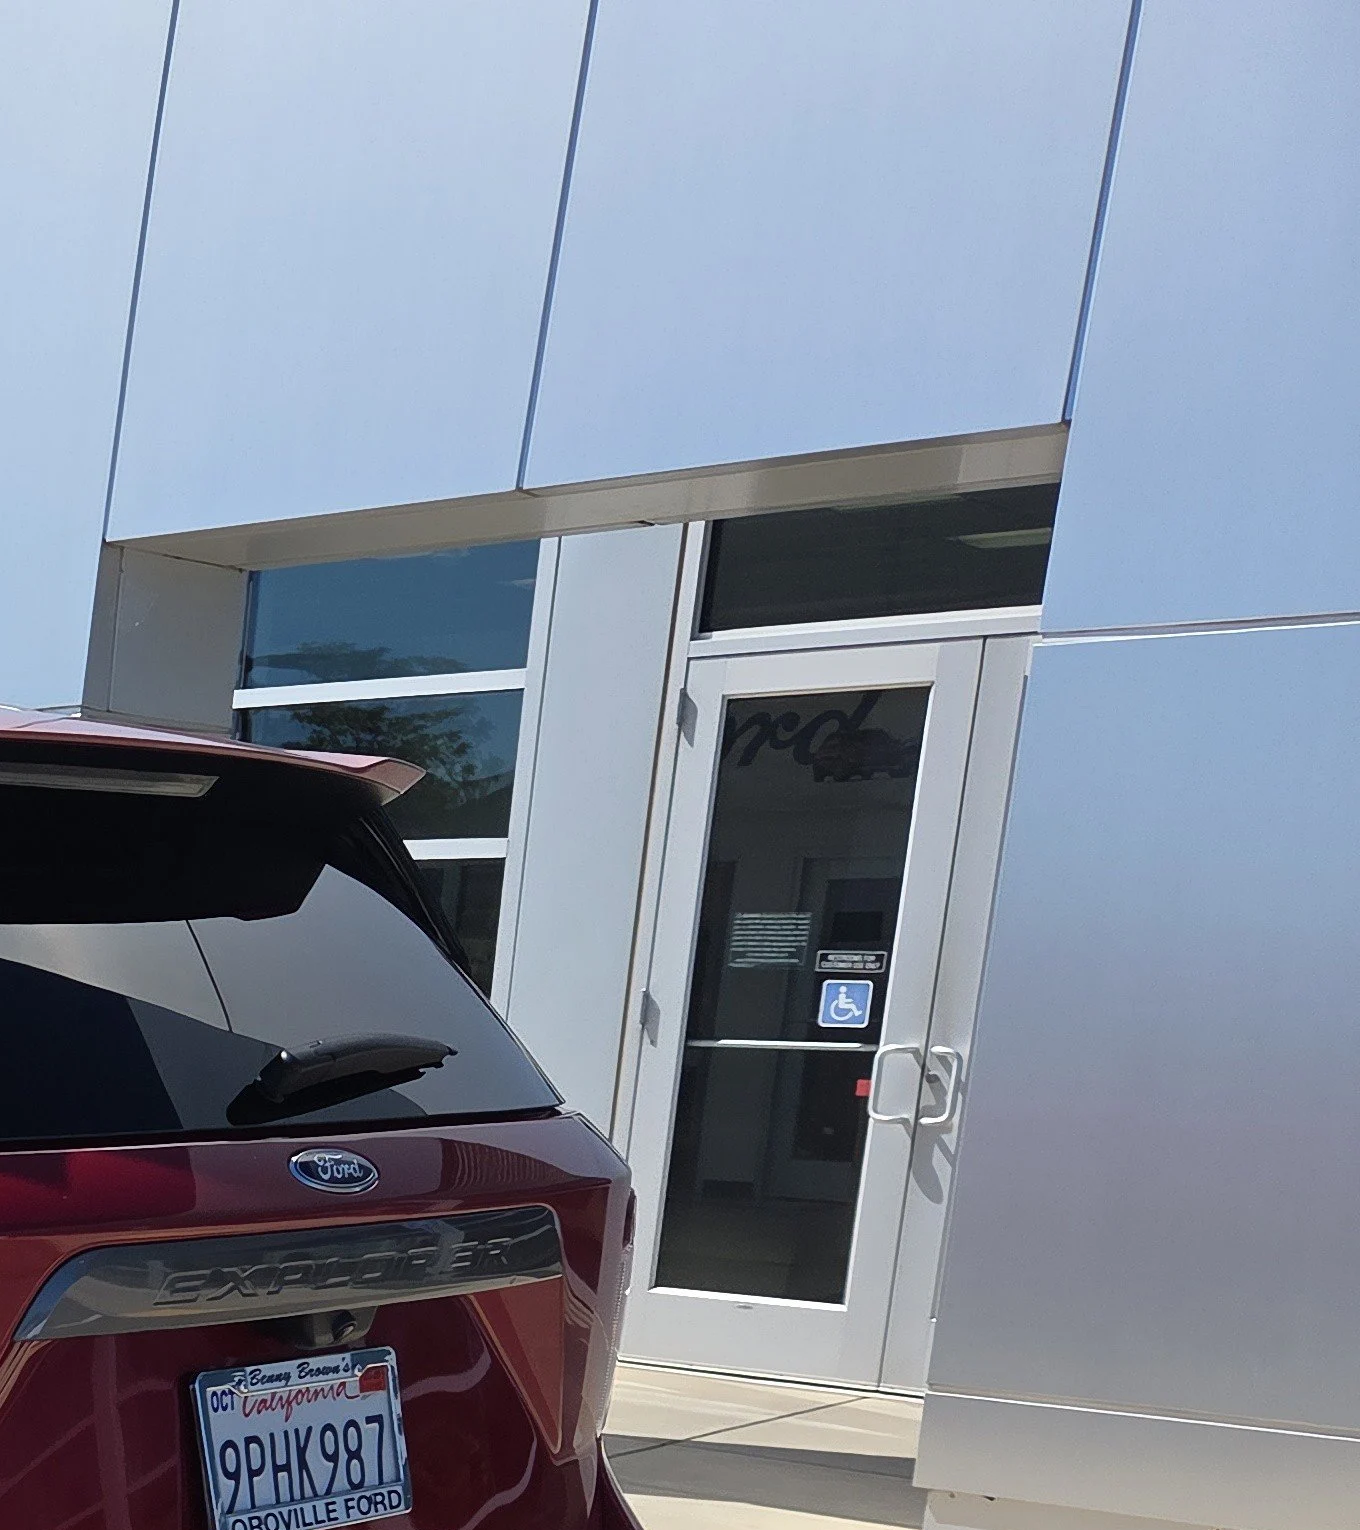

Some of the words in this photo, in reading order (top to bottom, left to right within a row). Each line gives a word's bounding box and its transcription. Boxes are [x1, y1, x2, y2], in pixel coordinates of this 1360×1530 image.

[152, 1236, 513, 1307] EXPLORER
[248, 1368, 292, 1388] Benny
[296, 1357, 351, 1380] Brown's
[210, 1389, 235, 1414] OCT
[241, 1380, 361, 1423] California
[219, 1413, 385, 1515] 9PHK987
[345, 1488, 403, 1519] FORD
